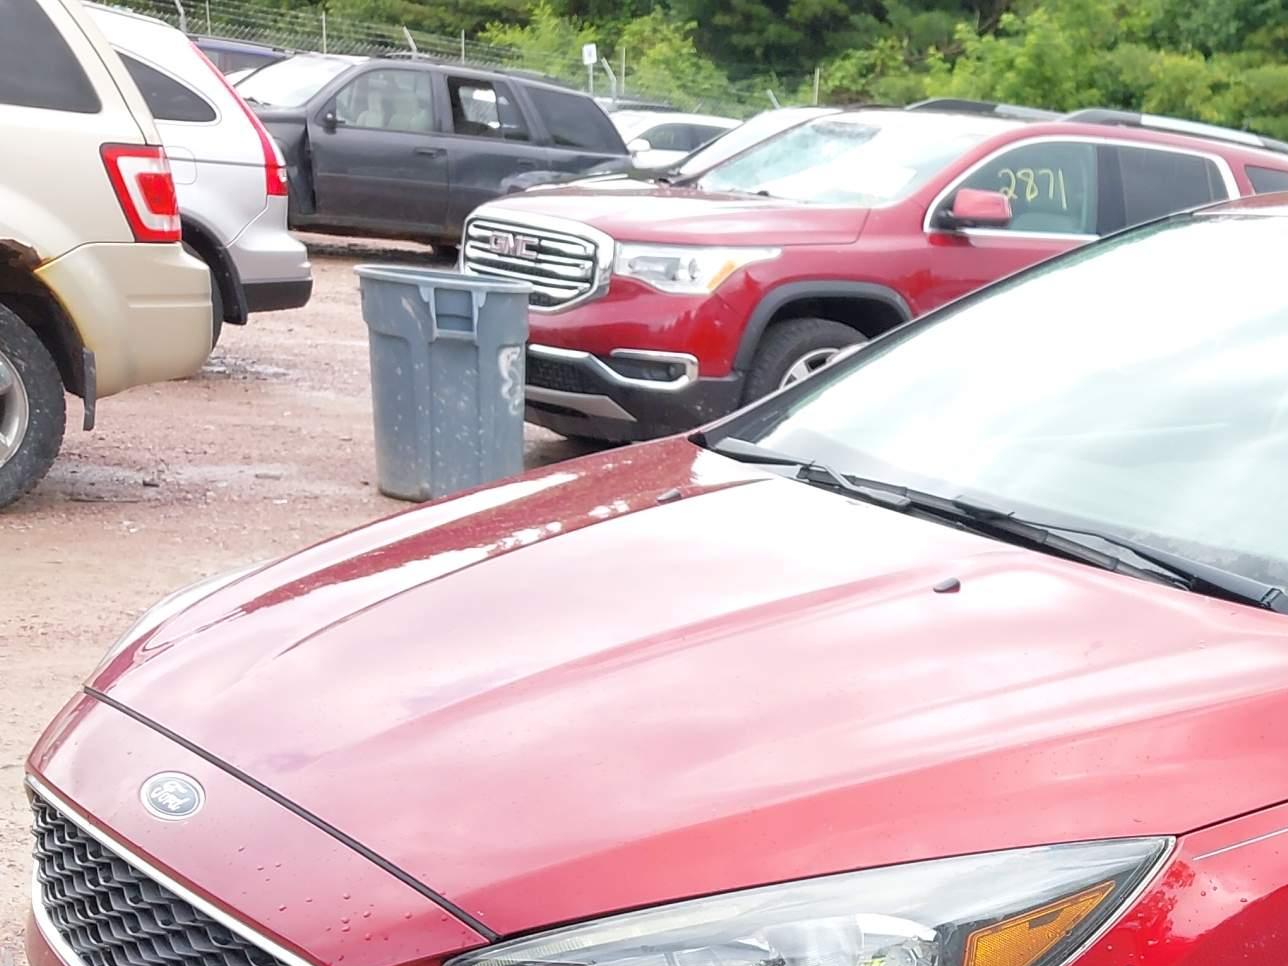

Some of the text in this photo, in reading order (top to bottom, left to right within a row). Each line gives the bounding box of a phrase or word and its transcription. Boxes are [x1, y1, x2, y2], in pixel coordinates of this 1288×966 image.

[997, 167, 1068, 211] 2871
[489, 229, 540, 261] GMC
[150, 779, 191, 812] Ford
